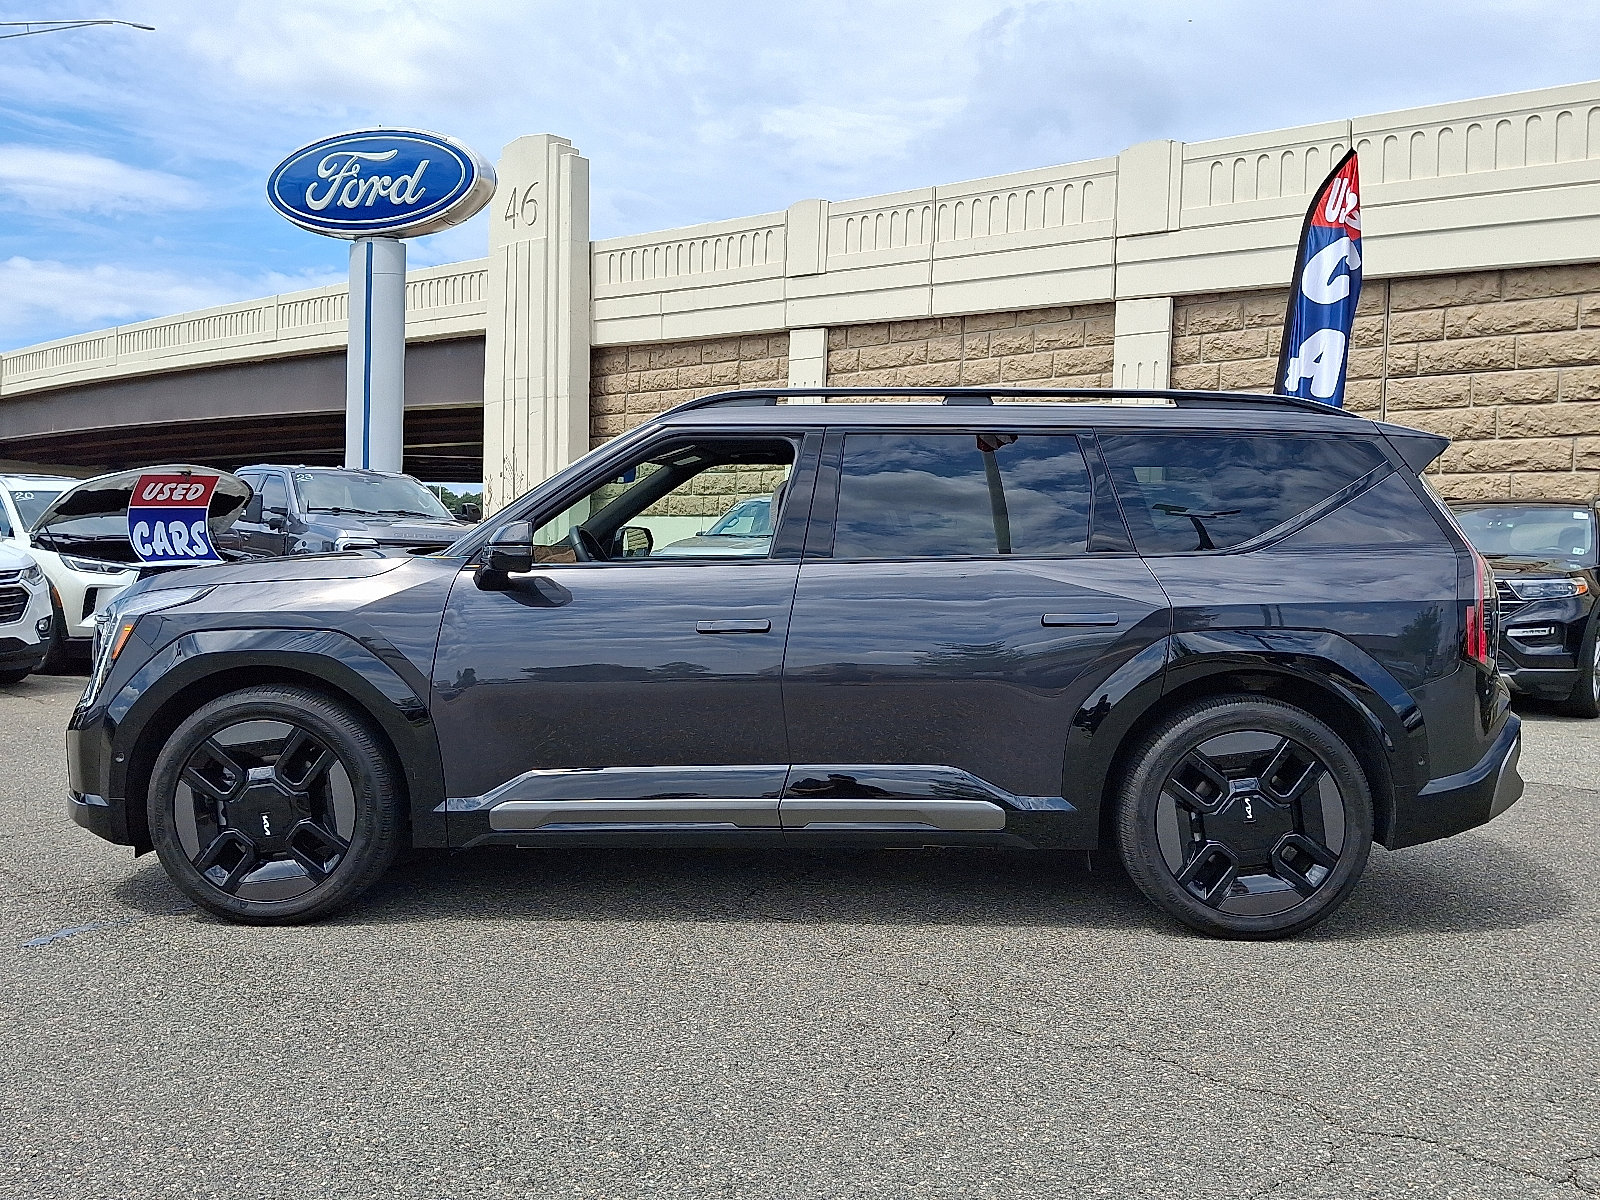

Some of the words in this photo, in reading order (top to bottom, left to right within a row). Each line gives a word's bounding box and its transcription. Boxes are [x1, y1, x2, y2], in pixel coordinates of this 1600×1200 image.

[306, 149, 430, 211] Ford
[504, 182, 540, 230] 46
[1285, 236, 1362, 398] CA
[142, 483, 205, 501] USED
[296, 473, 314, 481] 23
[15, 491, 35, 501] 20
[132, 520, 209, 557] CARS
